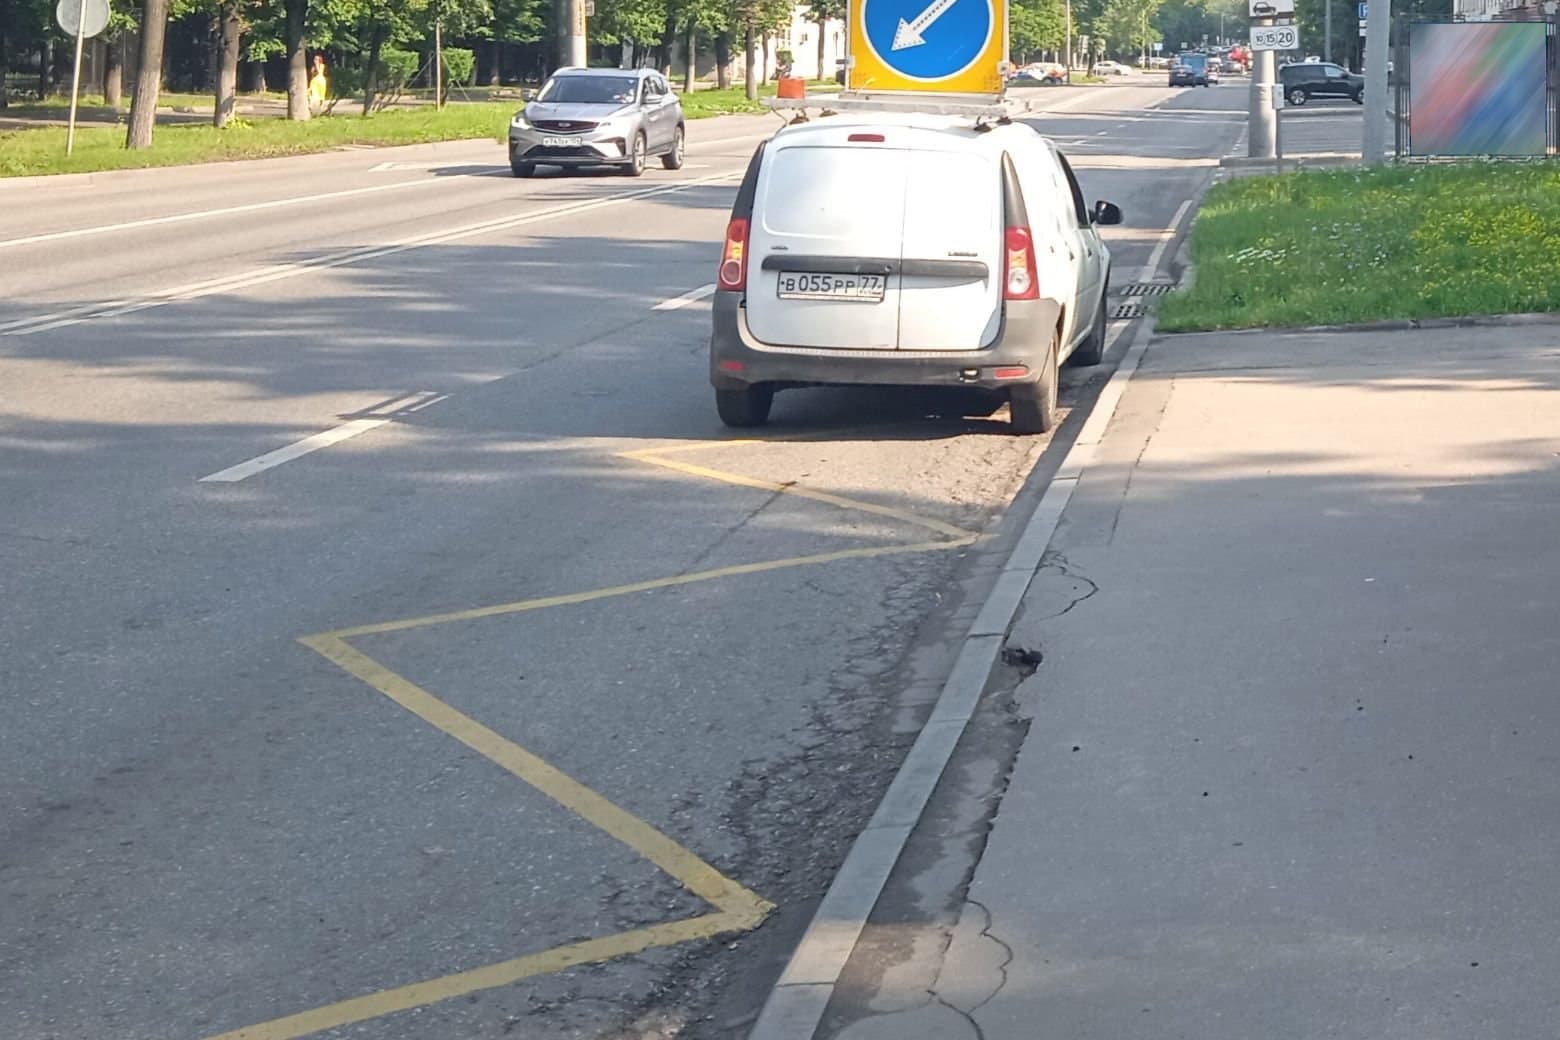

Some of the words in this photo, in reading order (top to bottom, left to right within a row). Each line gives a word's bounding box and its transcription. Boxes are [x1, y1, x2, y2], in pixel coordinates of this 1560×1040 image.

[1265, 33, 1276, 43] 15
[1278, 32, 1293, 43] 20
[861, 276, 878, 290] 77
